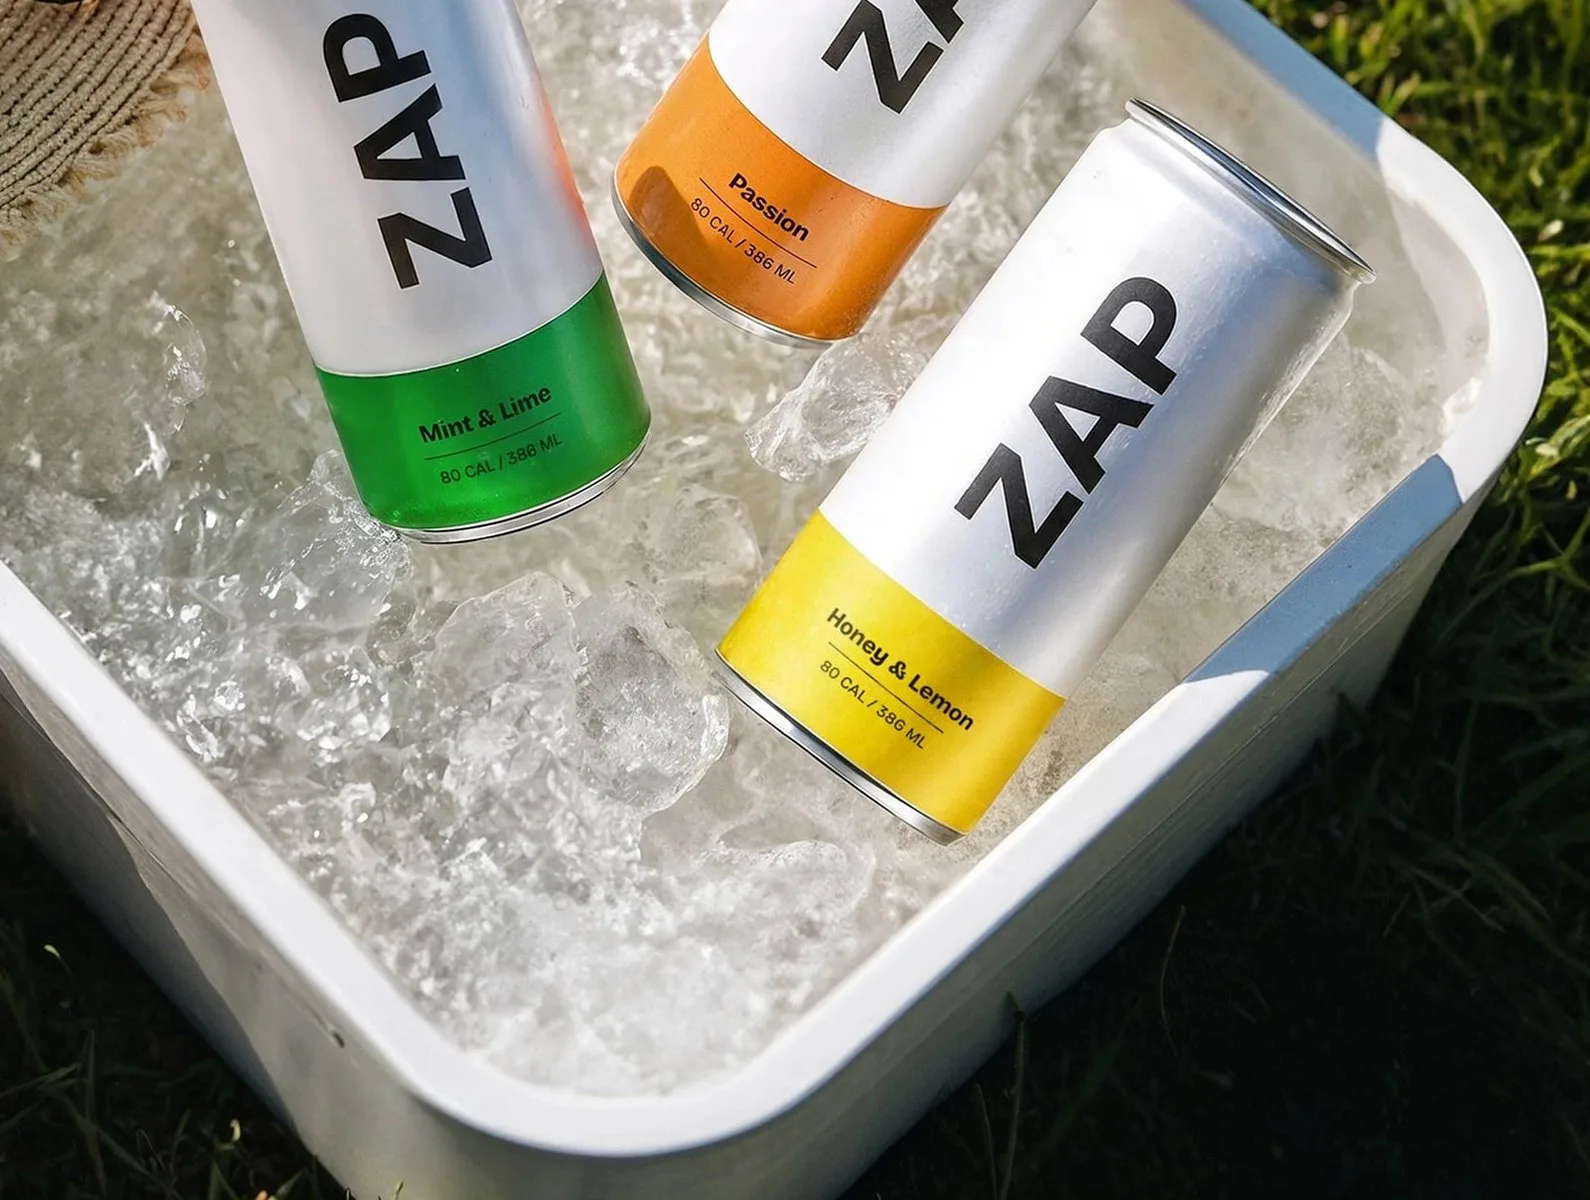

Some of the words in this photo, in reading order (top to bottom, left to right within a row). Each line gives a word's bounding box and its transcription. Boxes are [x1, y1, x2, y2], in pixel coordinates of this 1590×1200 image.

[322, 12, 493, 289] ZAP
[690, 197, 710, 219] 80
[710, 216, 735, 245] CAL
[734, 238, 747, 249] /
[744, 243, 773, 271] 386
[773, 264, 796, 285] ML
[728, 172, 810, 242] Passion
[418, 416, 473, 444] Mint
[478, 408, 497, 428] &
[499, 386, 553, 421] Lime
[439, 467, 461, 485] 80
[464, 460, 496, 480] CAL
[498, 455, 504, 471] /
[507, 447, 538, 466] 386
[540, 432, 562, 452] ML
[955, 277, 1177, 569] ZAP
[819, 660, 840, 681] 80
[839, 677, 866, 704] CAL
[866, 699, 878, 709] /
[876, 707, 906, 732] 386
[905, 728, 926, 749] ML
[826, 607, 889, 667] Honey
[888, 661, 907, 680] &
[907, 673, 974, 732] Lemon
